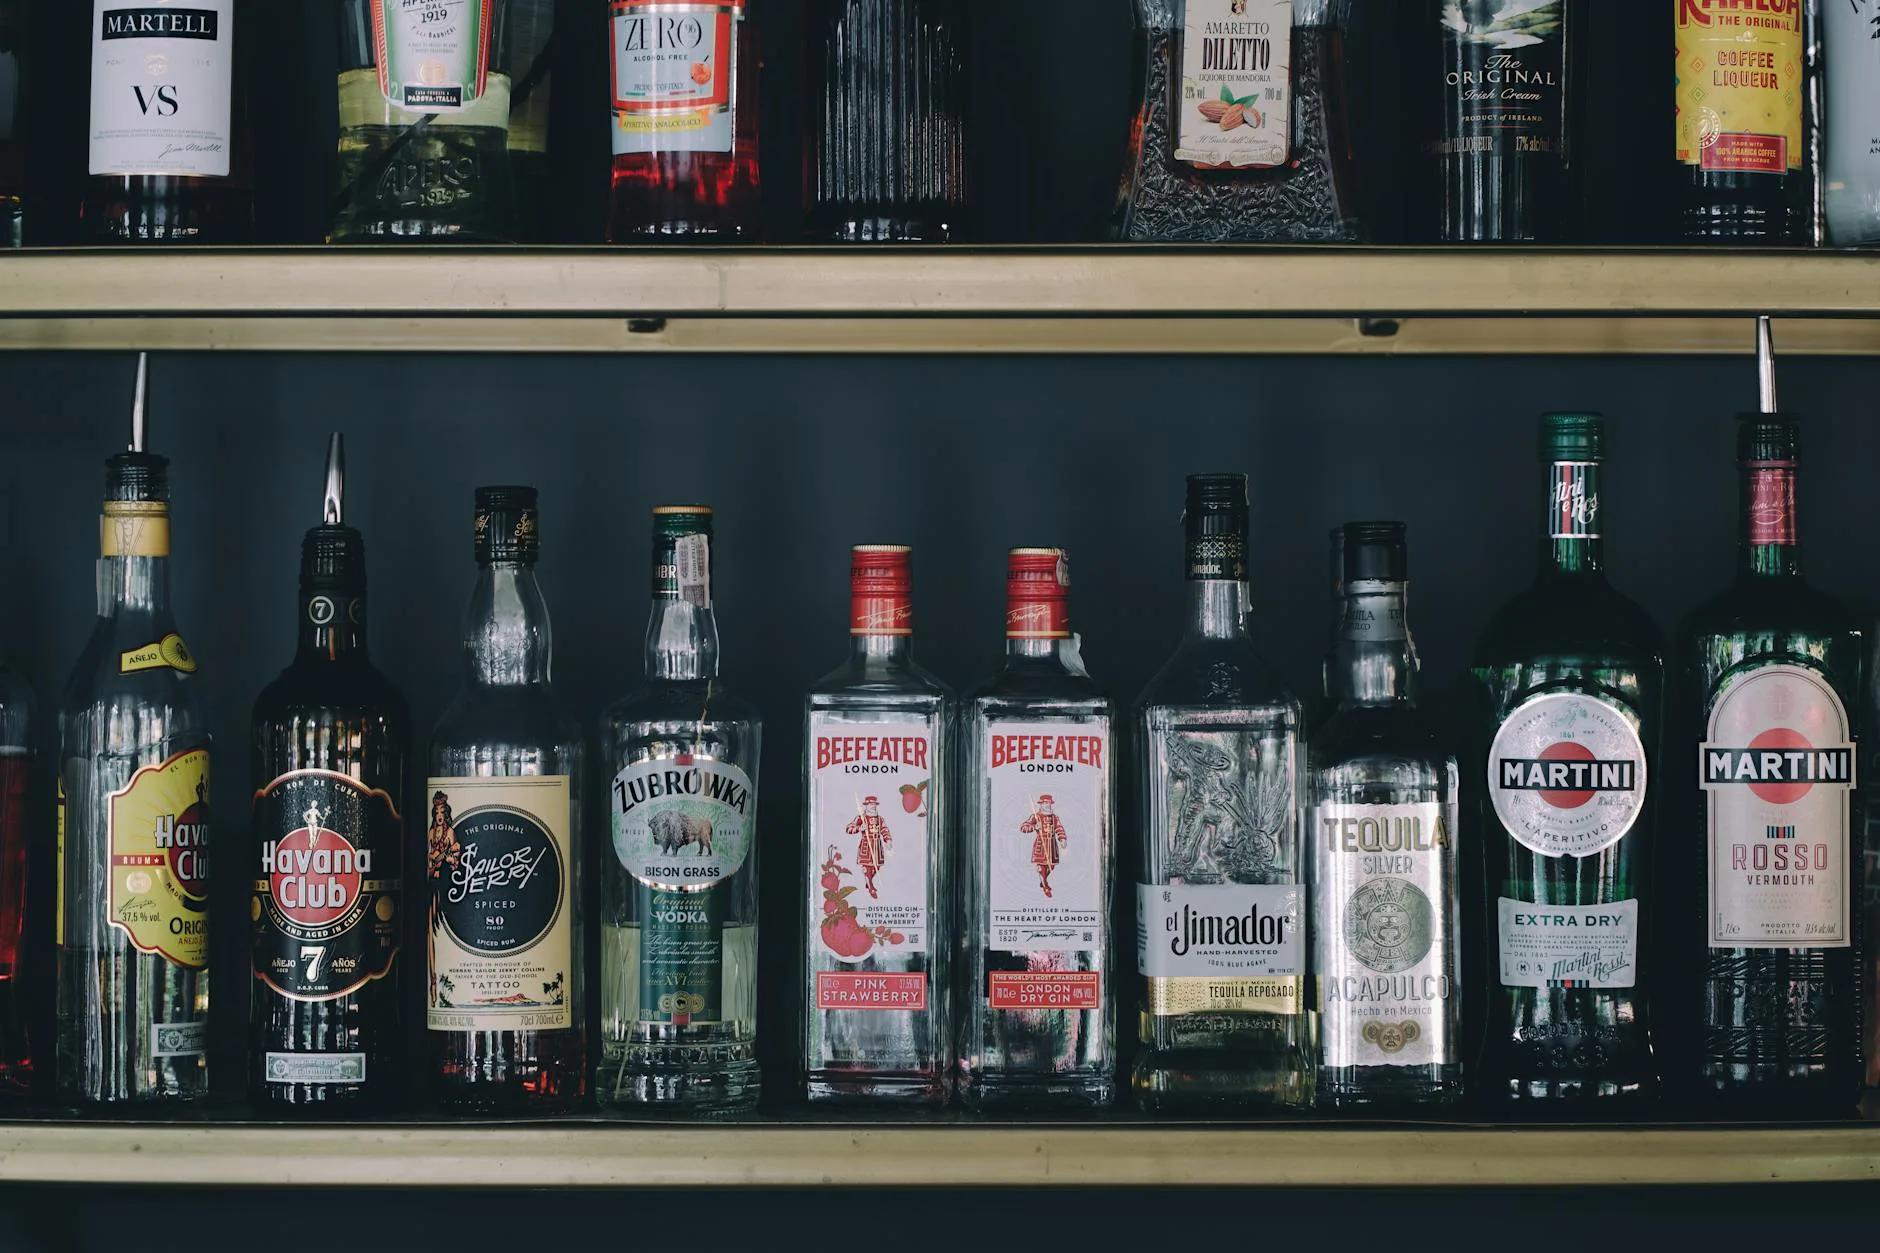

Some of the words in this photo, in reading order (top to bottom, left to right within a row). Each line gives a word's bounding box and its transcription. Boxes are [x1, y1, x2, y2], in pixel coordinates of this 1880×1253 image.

[421, 9, 447, 23] 1919
[107, 14, 211, 34] MARTELL
[1204, 22, 1270, 35] AMARETTO
[1718, 16, 1741, 26] THE
[1745, 16, 1791, 31] ORIGINAL
[624, 17, 702, 51] ZERO
[1202, 37, 1270, 71] DILETTO
[1717, 50, 1774, 69] COFFEE
[1484, 54, 1522, 69] The
[1198, 74, 1227, 83] LIQUORE
[1227, 74, 1235, 82] DI
[1446, 70, 1556, 86] ORIGINAL
[1713, 70, 1779, 90] LIQUEUR
[131, 84, 179, 117] VS
[1265, 88, 1275, 101] 700
[1461, 88, 1497, 101] Irish
[1500, 88, 1542, 101] Cream
[1461, 114, 1497, 122] PRODUCT
[1499, 114, 1506, 122] of
[1508, 114, 1543, 122] IRELAND
[1516, 136, 1528, 152] 17%
[1716, 147, 1731, 156] 100%
[1732, 147, 1758, 157] ARABICA
[1757, 148, 1777, 158] COFFEE
[315, 602, 326, 619] 7
[129, 652, 158, 665] AÑEJO
[817, 737, 927, 770] BEEFEATER
[991, 735, 1102, 769] BEEFEATER
[845, 765, 898, 773] LONDON
[1020, 763, 1074, 773] LONDON
[1709, 751, 1848, 780] MARTINI
[1504, 761, 1630, 788] MARTINI
[286, 779, 304, 791] RON
[313, 779, 326, 787] DE
[334, 782, 359, 799] CUBA
[614, 768, 747, 815] ŻUBRÓWKA
[464, 824, 479, 836] THE
[482, 823, 525, 835] ORIGINAL
[1323, 816, 1449, 853] TEQUILA
[123, 855, 152, 865] RHUM
[262, 840, 372, 874] Havana
[1732, 843, 1828, 871] ROSSO
[177, 850, 208, 881] Clu
[451, 843, 533, 887] SAILOR
[645, 866, 679, 877] BISON
[683, 867, 720, 877] GRASS
[1363, 855, 1413, 874] SILVER
[1747, 874, 1815, 885] VERMOUTH
[279, 876, 347, 909] Club
[474, 900, 517, 909] SPICED
[653, 894, 707, 907] Original
[122, 912, 138, 922] 37.5
[139, 912, 147, 921] %
[269, 907, 285, 927] MADE
[285, 925, 302, 937] AND
[305, 930, 329, 938] AGED
[332, 925, 342, 934] IN
[343, 908, 363, 928] CUBA
[485, 916, 505, 926] 80
[656, 911, 708, 923] VODKA
[1166, 911, 1178, 932] el
[1515, 914, 1578, 927] EXTRA
[1585, 915, 1623, 927] DRY
[1171, 903, 1290, 956] Jimador
[178, 935, 199, 946] AÑEJO
[476, 938, 499, 947] SPICED
[501, 938, 516, 946] RUM
[271, 957, 296, 968] AÑEJO
[300, 945, 327, 983] 7
[331, 956, 356, 968] AÑOS
[1208, 959, 1225, 967] 100%
[1246, 959, 1266, 967] AGAVE
[1593, 952, 1630, 983] Rossi
[470, 981, 520, 989] TATTOO
[664, 975, 687, 986] XVI
[854, 979, 887, 989] PINK
[1020, 984, 1071, 993] LONDON
[1209, 986, 1246, 998] TEQUILA
[1248, 985, 1294, 998] REPOSADO
[1327, 975, 1450, 1002] ACAPULCO
[823, 991, 919, 1001] STRAWBERRY
[1020, 994, 1045, 1003] DRY
[1048, 994, 1071, 1003] GIN
[1351, 1006, 1381, 1017] Hecho
[1384, 1008, 1397, 1017] en
[1399, 1006, 1432, 1017] Mexico
